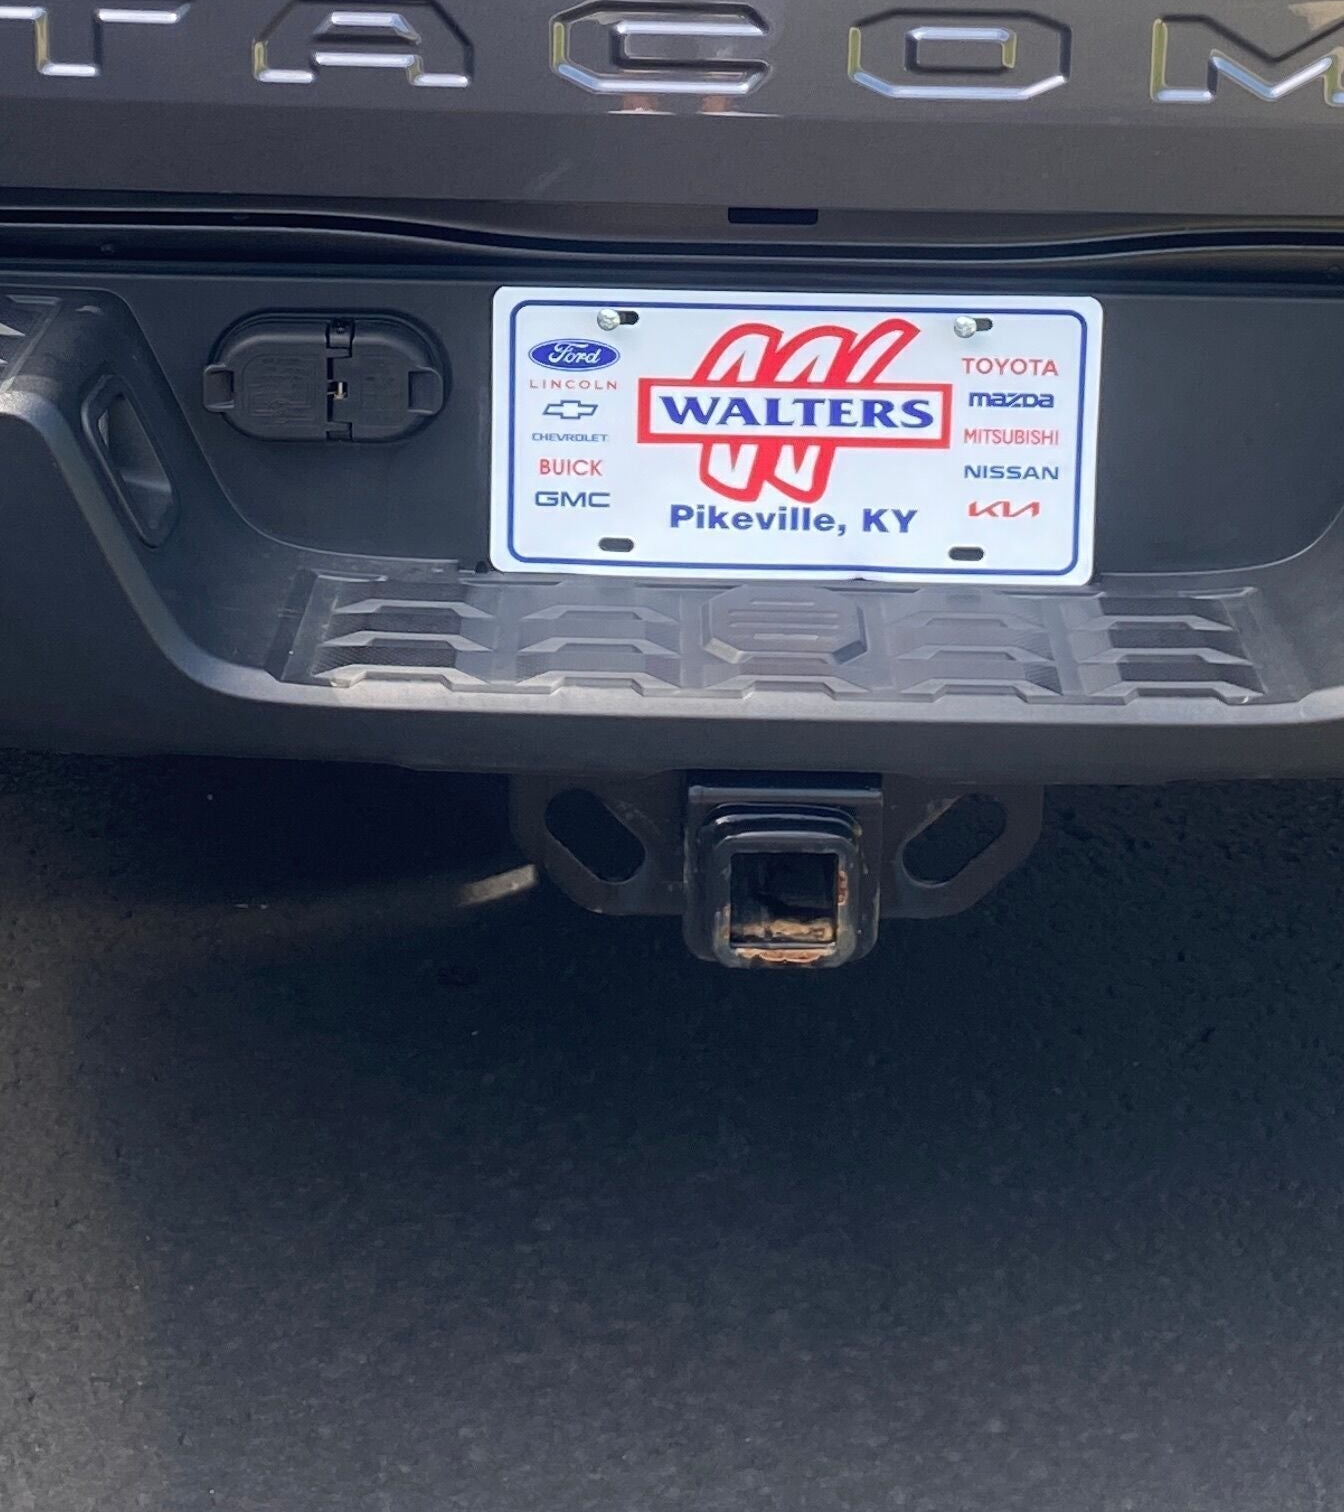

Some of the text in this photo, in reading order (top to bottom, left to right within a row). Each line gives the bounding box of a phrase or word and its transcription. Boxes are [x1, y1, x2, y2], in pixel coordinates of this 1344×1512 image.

[548, 343, 602, 364] Ford
[961, 357, 1059, 376] TOYOTA
[529, 379, 618, 390] LINCOLN
[659, 395, 934, 428] WALTERS
[531, 432, 609, 443] CHEVROLET
[963, 428, 1060, 446] MITSUBISHI
[538, 458, 603, 477] BUICK
[963, 464, 1060, 480] NISSAN
[534, 490, 611, 508] GMC
[669, 504, 919, 537] Pikeville, KY
